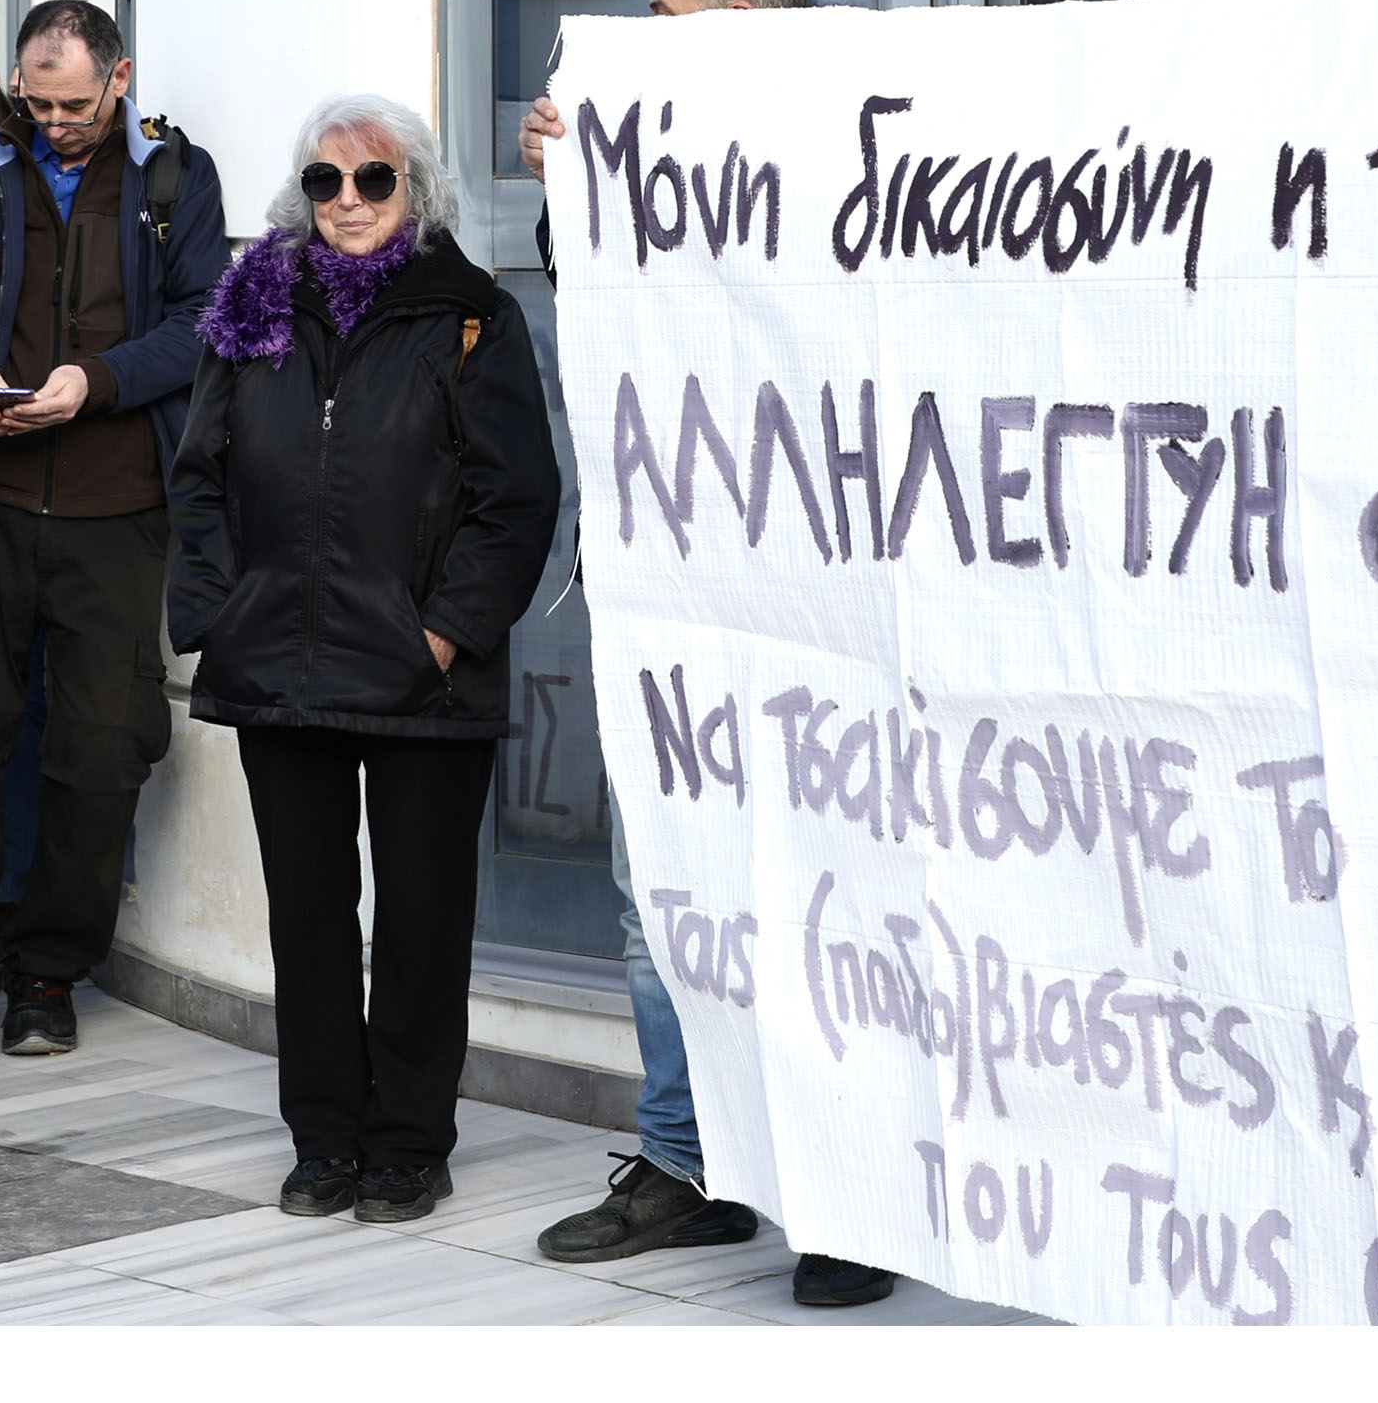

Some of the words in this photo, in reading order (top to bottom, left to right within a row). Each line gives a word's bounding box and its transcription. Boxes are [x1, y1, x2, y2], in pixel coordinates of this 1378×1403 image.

[576, 94, 782, 276] Μόνη
[831, 93, 1214, 300] δικαιοσύνη
[1270, 139, 1331, 265] η
[612, 372, 1289, 594] ΑΛΛΗΛΕΓΓΥΗ
